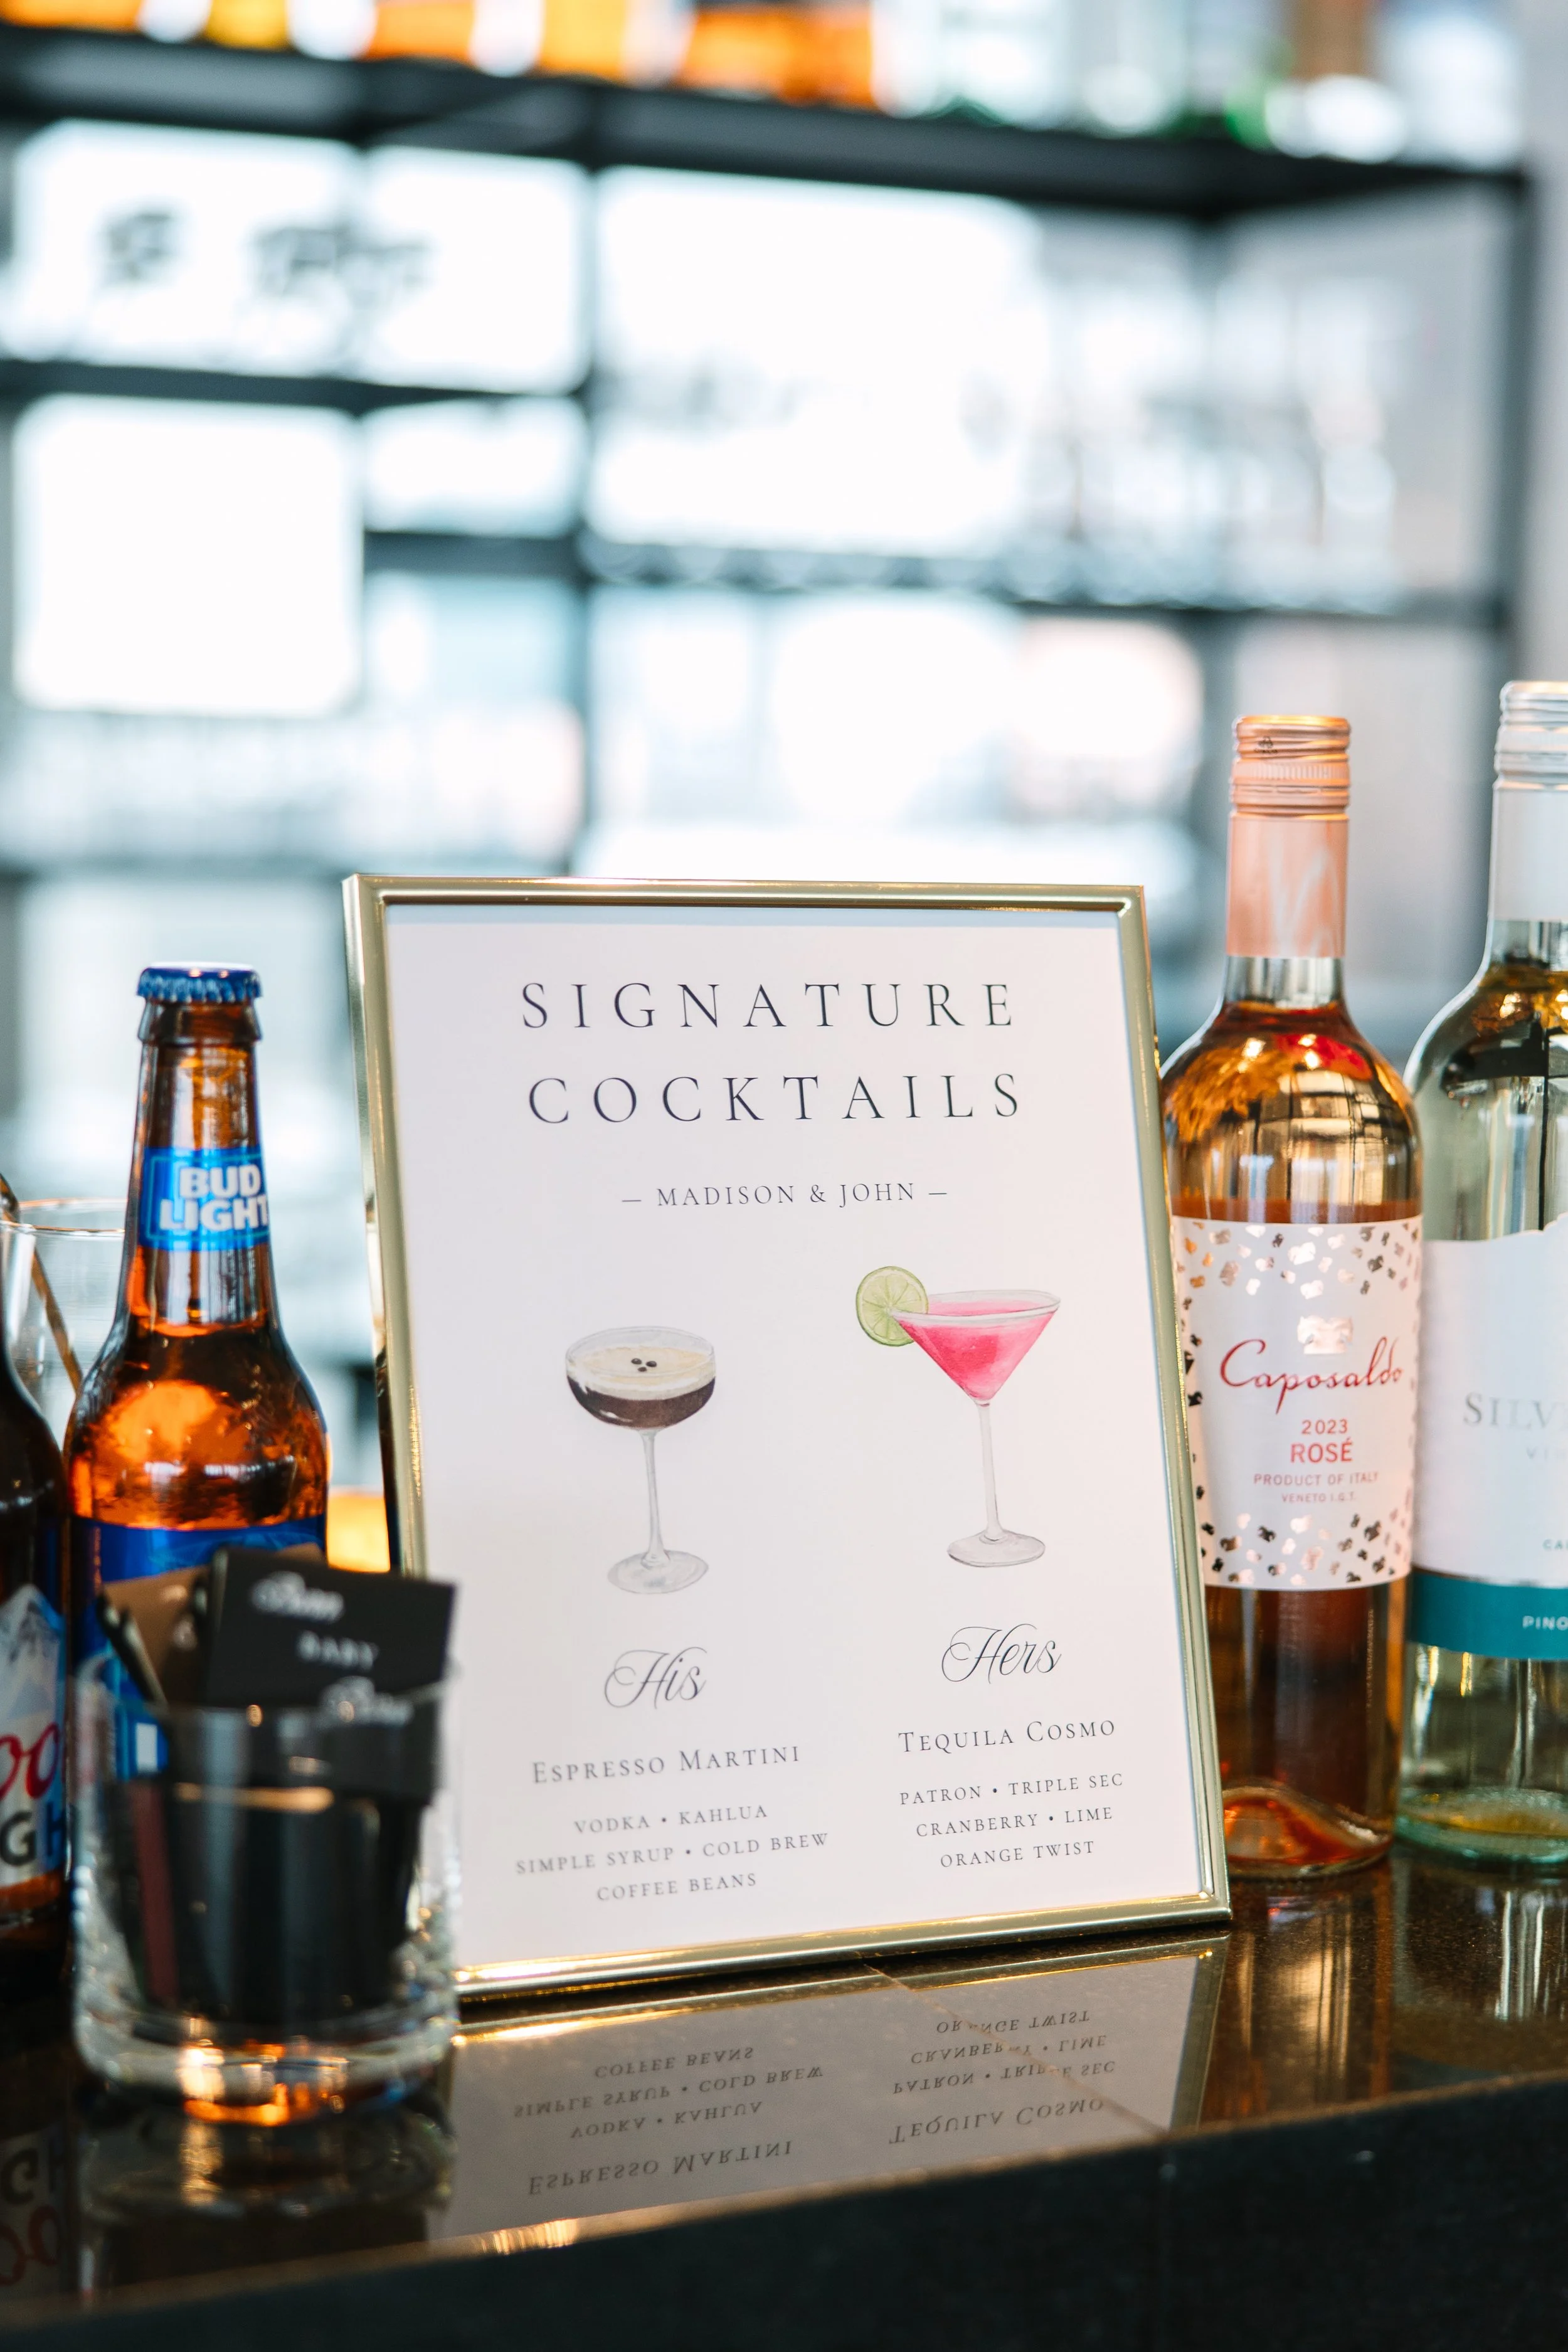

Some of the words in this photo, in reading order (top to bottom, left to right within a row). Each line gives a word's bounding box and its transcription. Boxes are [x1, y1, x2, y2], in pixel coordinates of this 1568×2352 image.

[522, 982, 1012, 1029] SIGNATURE
[528, 1073, 1018, 1124] COCKTAILS
[179, 1165, 261, 1197] BUD
[657, 1185, 794, 1207] MADISON
[809, 1184, 827, 1203] &
[839, 1182, 913, 1209] JOHN
[159, 1195, 268, 1231] LIGHT
[1219, 1337, 1404, 1414] Caposaldo
[1301, 1418, 1348, 1435] 2023
[1463, 1391, 1568, 1428] SILV
[1290, 1436, 1353, 1463] ROSÉ
[1253, 1473, 1322, 1486] PRODUCT
[1328, 1474, 1344, 1485] OF
[1350, 1471, 1379, 1484] ITALY
[1282, 1493, 1327, 1503] VENETO
[941, 1623, 1062, 1684] Hers
[603, 1646, 707, 1709] His
[898, 1729, 1014, 1755] TEQUILA
[1026, 1720, 1115, 1742] COSMO
[532, 1756, 665, 1784] ESPRESSO
[679, 1745, 799, 1772] MARTINI
[899, 1785, 981, 1806] PATRON
[1007, 1777, 1079, 1796] TRIPLE
[1088, 1772, 1123, 1789] SEC
[573, 1815, 650, 1834] VODKA
[679, 1804, 768, 1826] KAHLUA
[916, 1813, 1038, 1837] CRANBERRY
[1064, 1806, 1113, 1824] LIME
[516, 1853, 596, 1875] SIMPLE
[606, 1846, 674, 1867] SYRUP
[702, 1839, 760, 1857] COLD
[770, 1832, 828, 1851] BREW
[940, 1847, 1024, 1868] ORANGE
[1032, 1840, 1094, 1859] TWIST
[596, 1880, 678, 1902] COFFEE
[688, 1872, 756, 1893] BEANS
